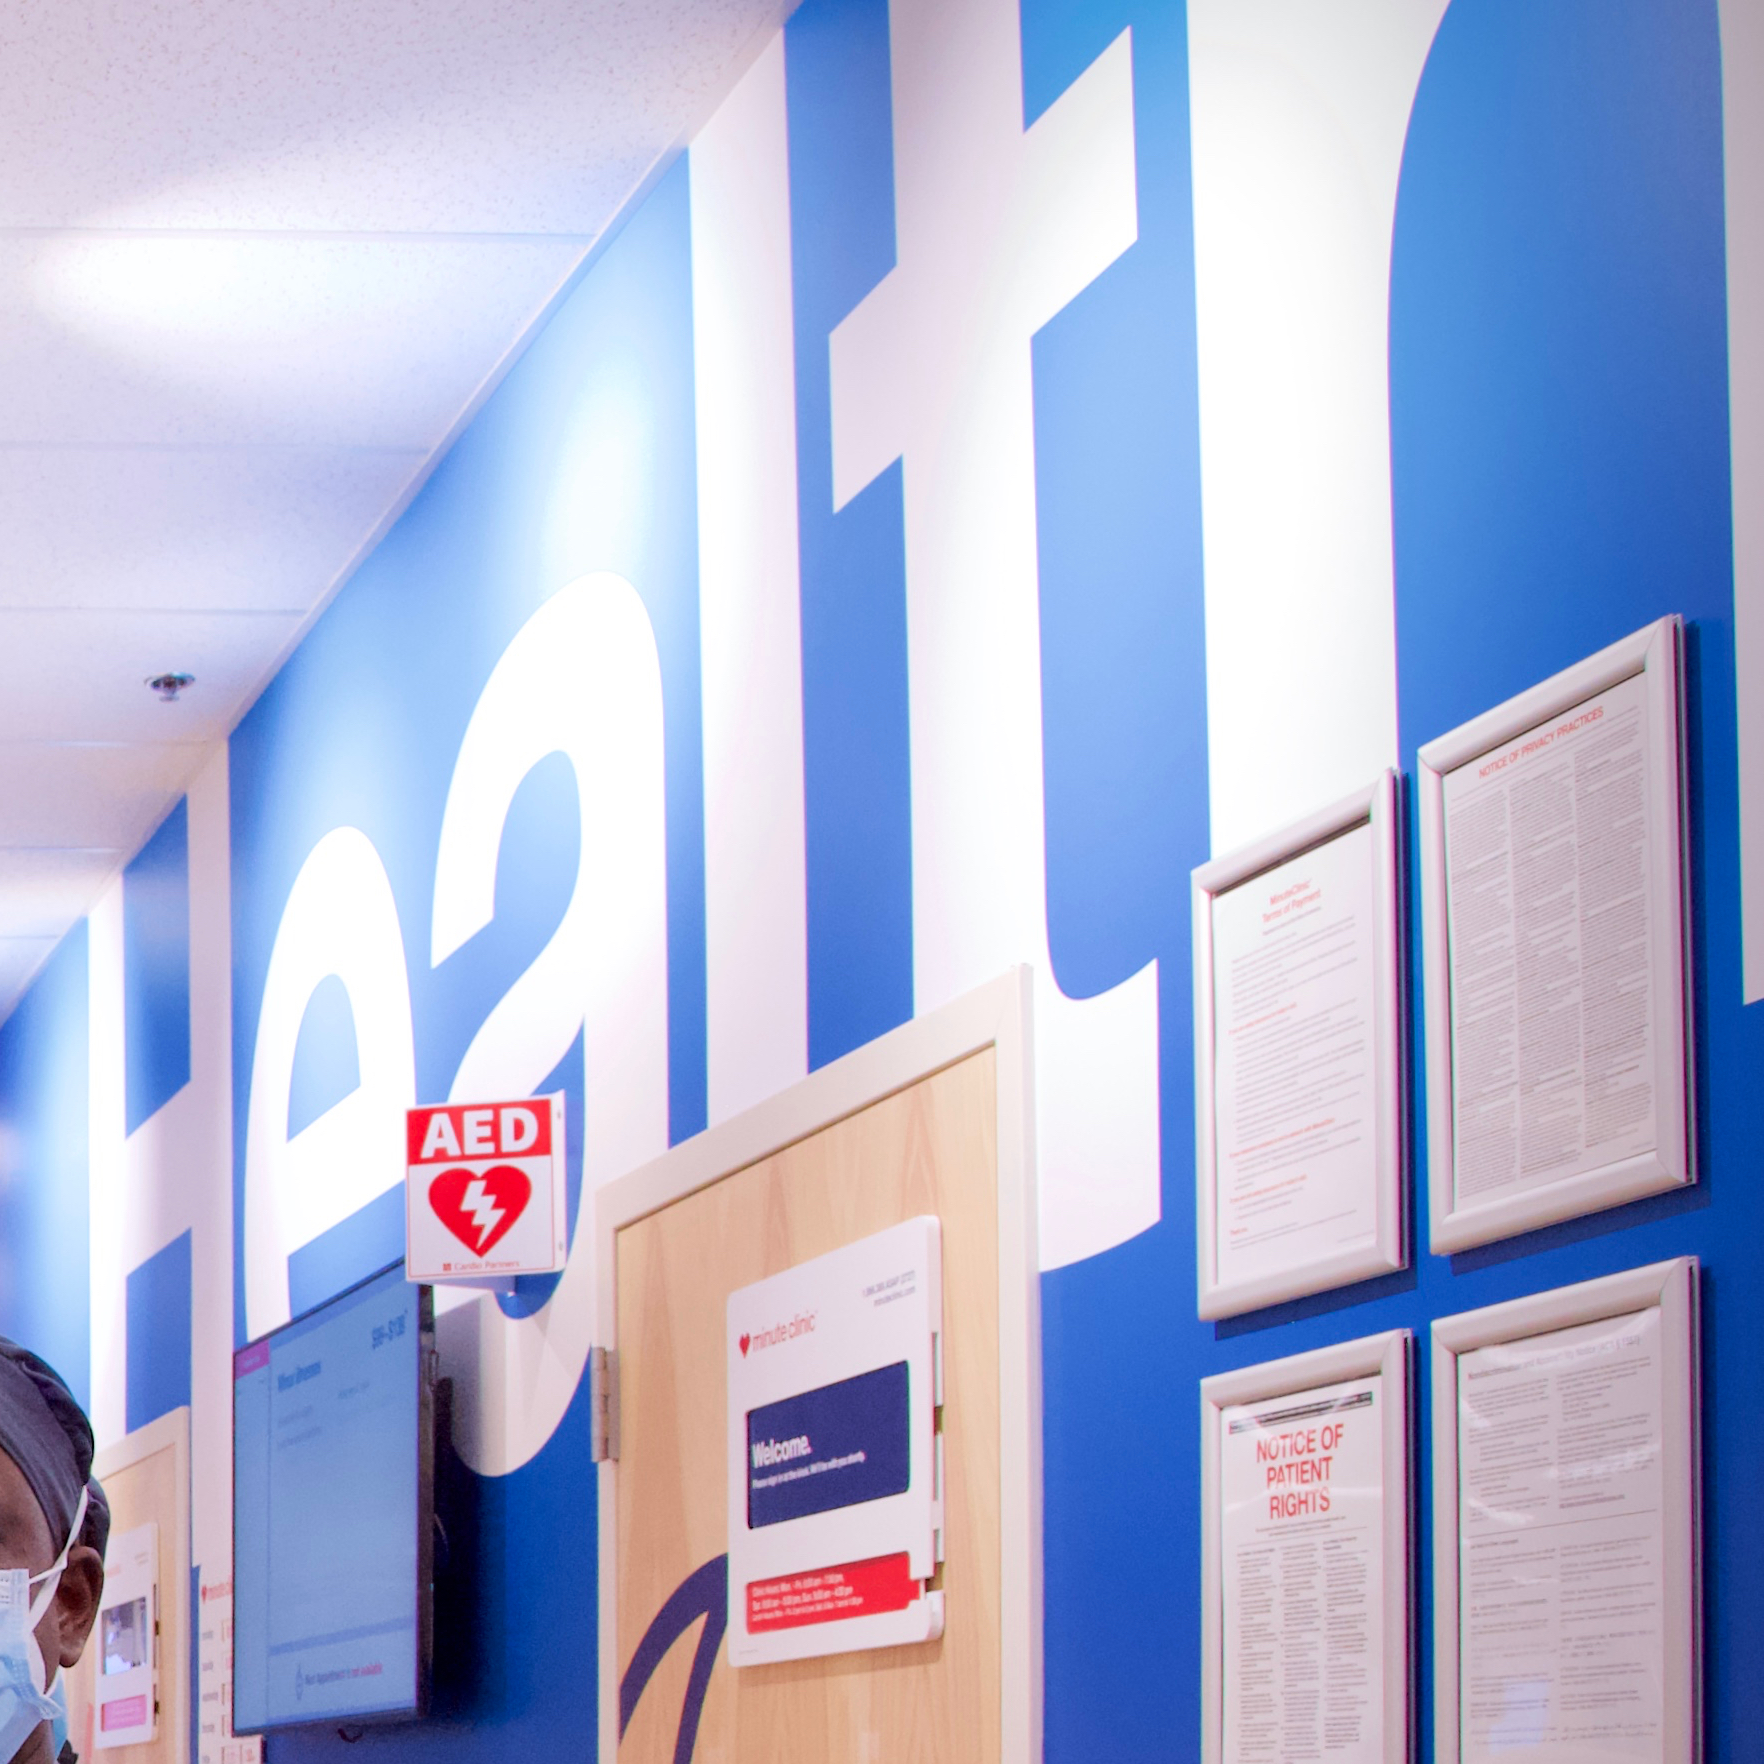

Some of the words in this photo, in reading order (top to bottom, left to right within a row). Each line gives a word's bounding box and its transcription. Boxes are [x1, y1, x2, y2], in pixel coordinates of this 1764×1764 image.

[1479, 756, 1507, 779] NOTICE
[1509, 749, 1520, 763] OF
[1522, 732, 1555, 757] PRIVACY
[1557, 706, 1604, 739] PRACTICES
[420, 1107, 538, 1159] AED
[752, 1323, 787, 1352] minute
[789, 1311, 815, 1341] clinic
[752, 1435, 812, 1468] Welcome.
[1256, 1429, 1316, 1463] NOTICE
[1321, 1423, 1344, 1451] OF
[1266, 1456, 1333, 1489] PATIENT
[1270, 1486, 1330, 1520] RIGHTS
